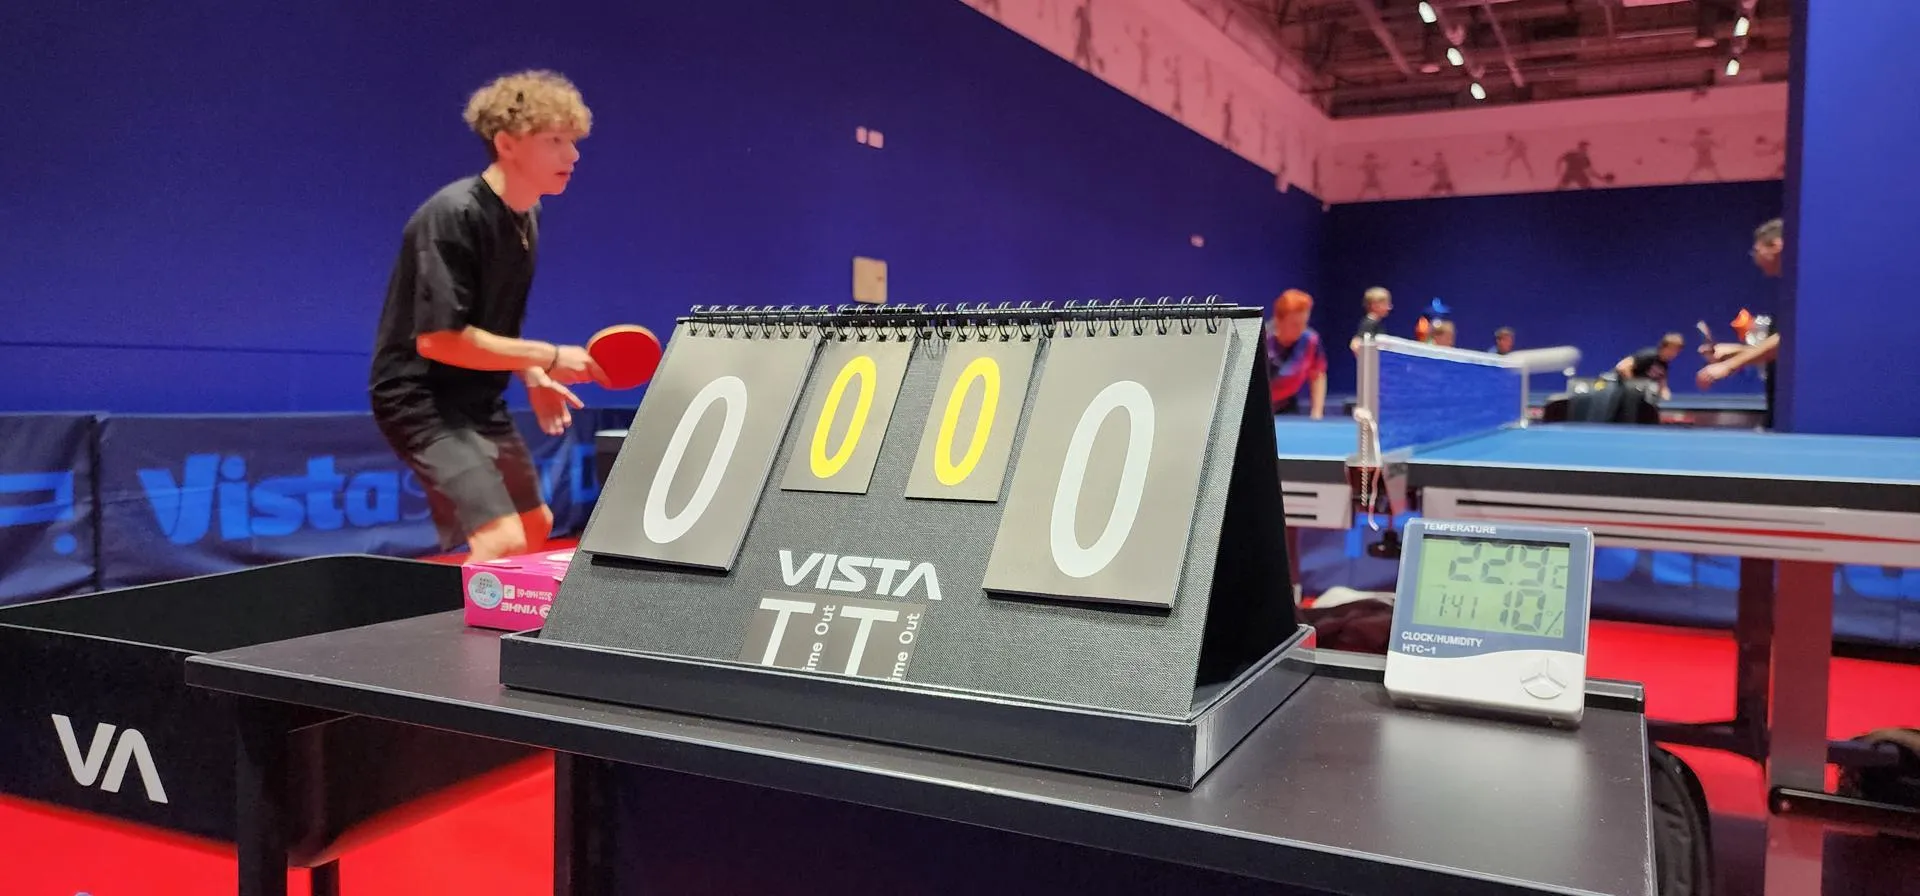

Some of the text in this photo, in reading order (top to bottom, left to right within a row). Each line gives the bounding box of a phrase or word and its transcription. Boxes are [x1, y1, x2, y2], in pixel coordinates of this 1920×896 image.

[810, 355, 876, 478] 0
[934, 356, 1000, 486] 0
[643, 376, 747, 544] 0
[1050, 380, 1155, 578] 0
[1424, 522, 1496, 534] TEMPERATURE
[778, 549, 943, 601] VISTA
[501, 602, 538, 615] YINHE
[759, 598, 817, 667] T
[814, 604, 837, 636] Out
[898, 612, 921, 645] Out
[840, 605, 900, 676] T
[1401, 631, 1483, 647] CLOCK/HUMIDITY
[1402, 643, 1437, 654] HTC-1
